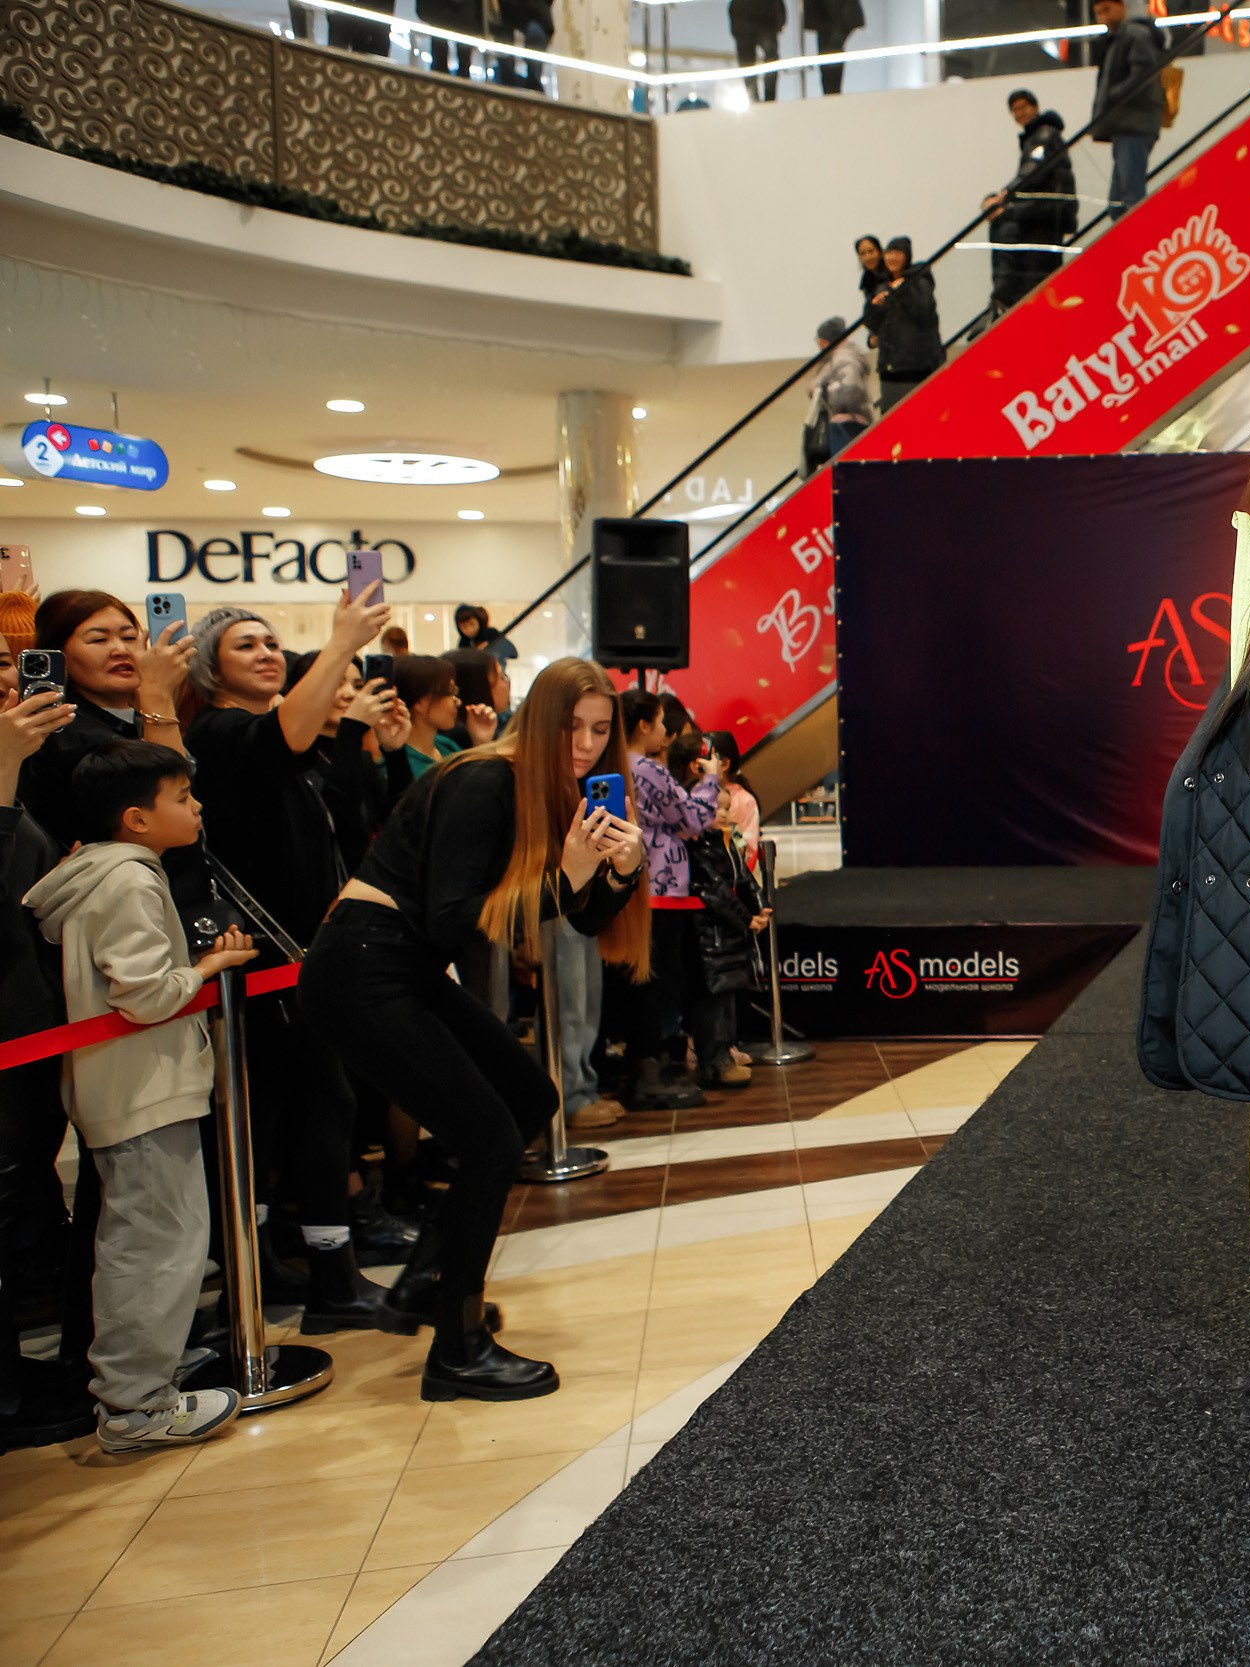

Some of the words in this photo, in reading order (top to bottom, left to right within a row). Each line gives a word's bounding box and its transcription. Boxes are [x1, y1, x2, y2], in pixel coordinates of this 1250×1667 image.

[1136, 319, 1208, 385] mall
[1001, 323, 1145, 450] Batyr
[37, 442, 48, 461] 2
[864, 949, 917, 998] AS
[920, 951, 1020, 977] models
